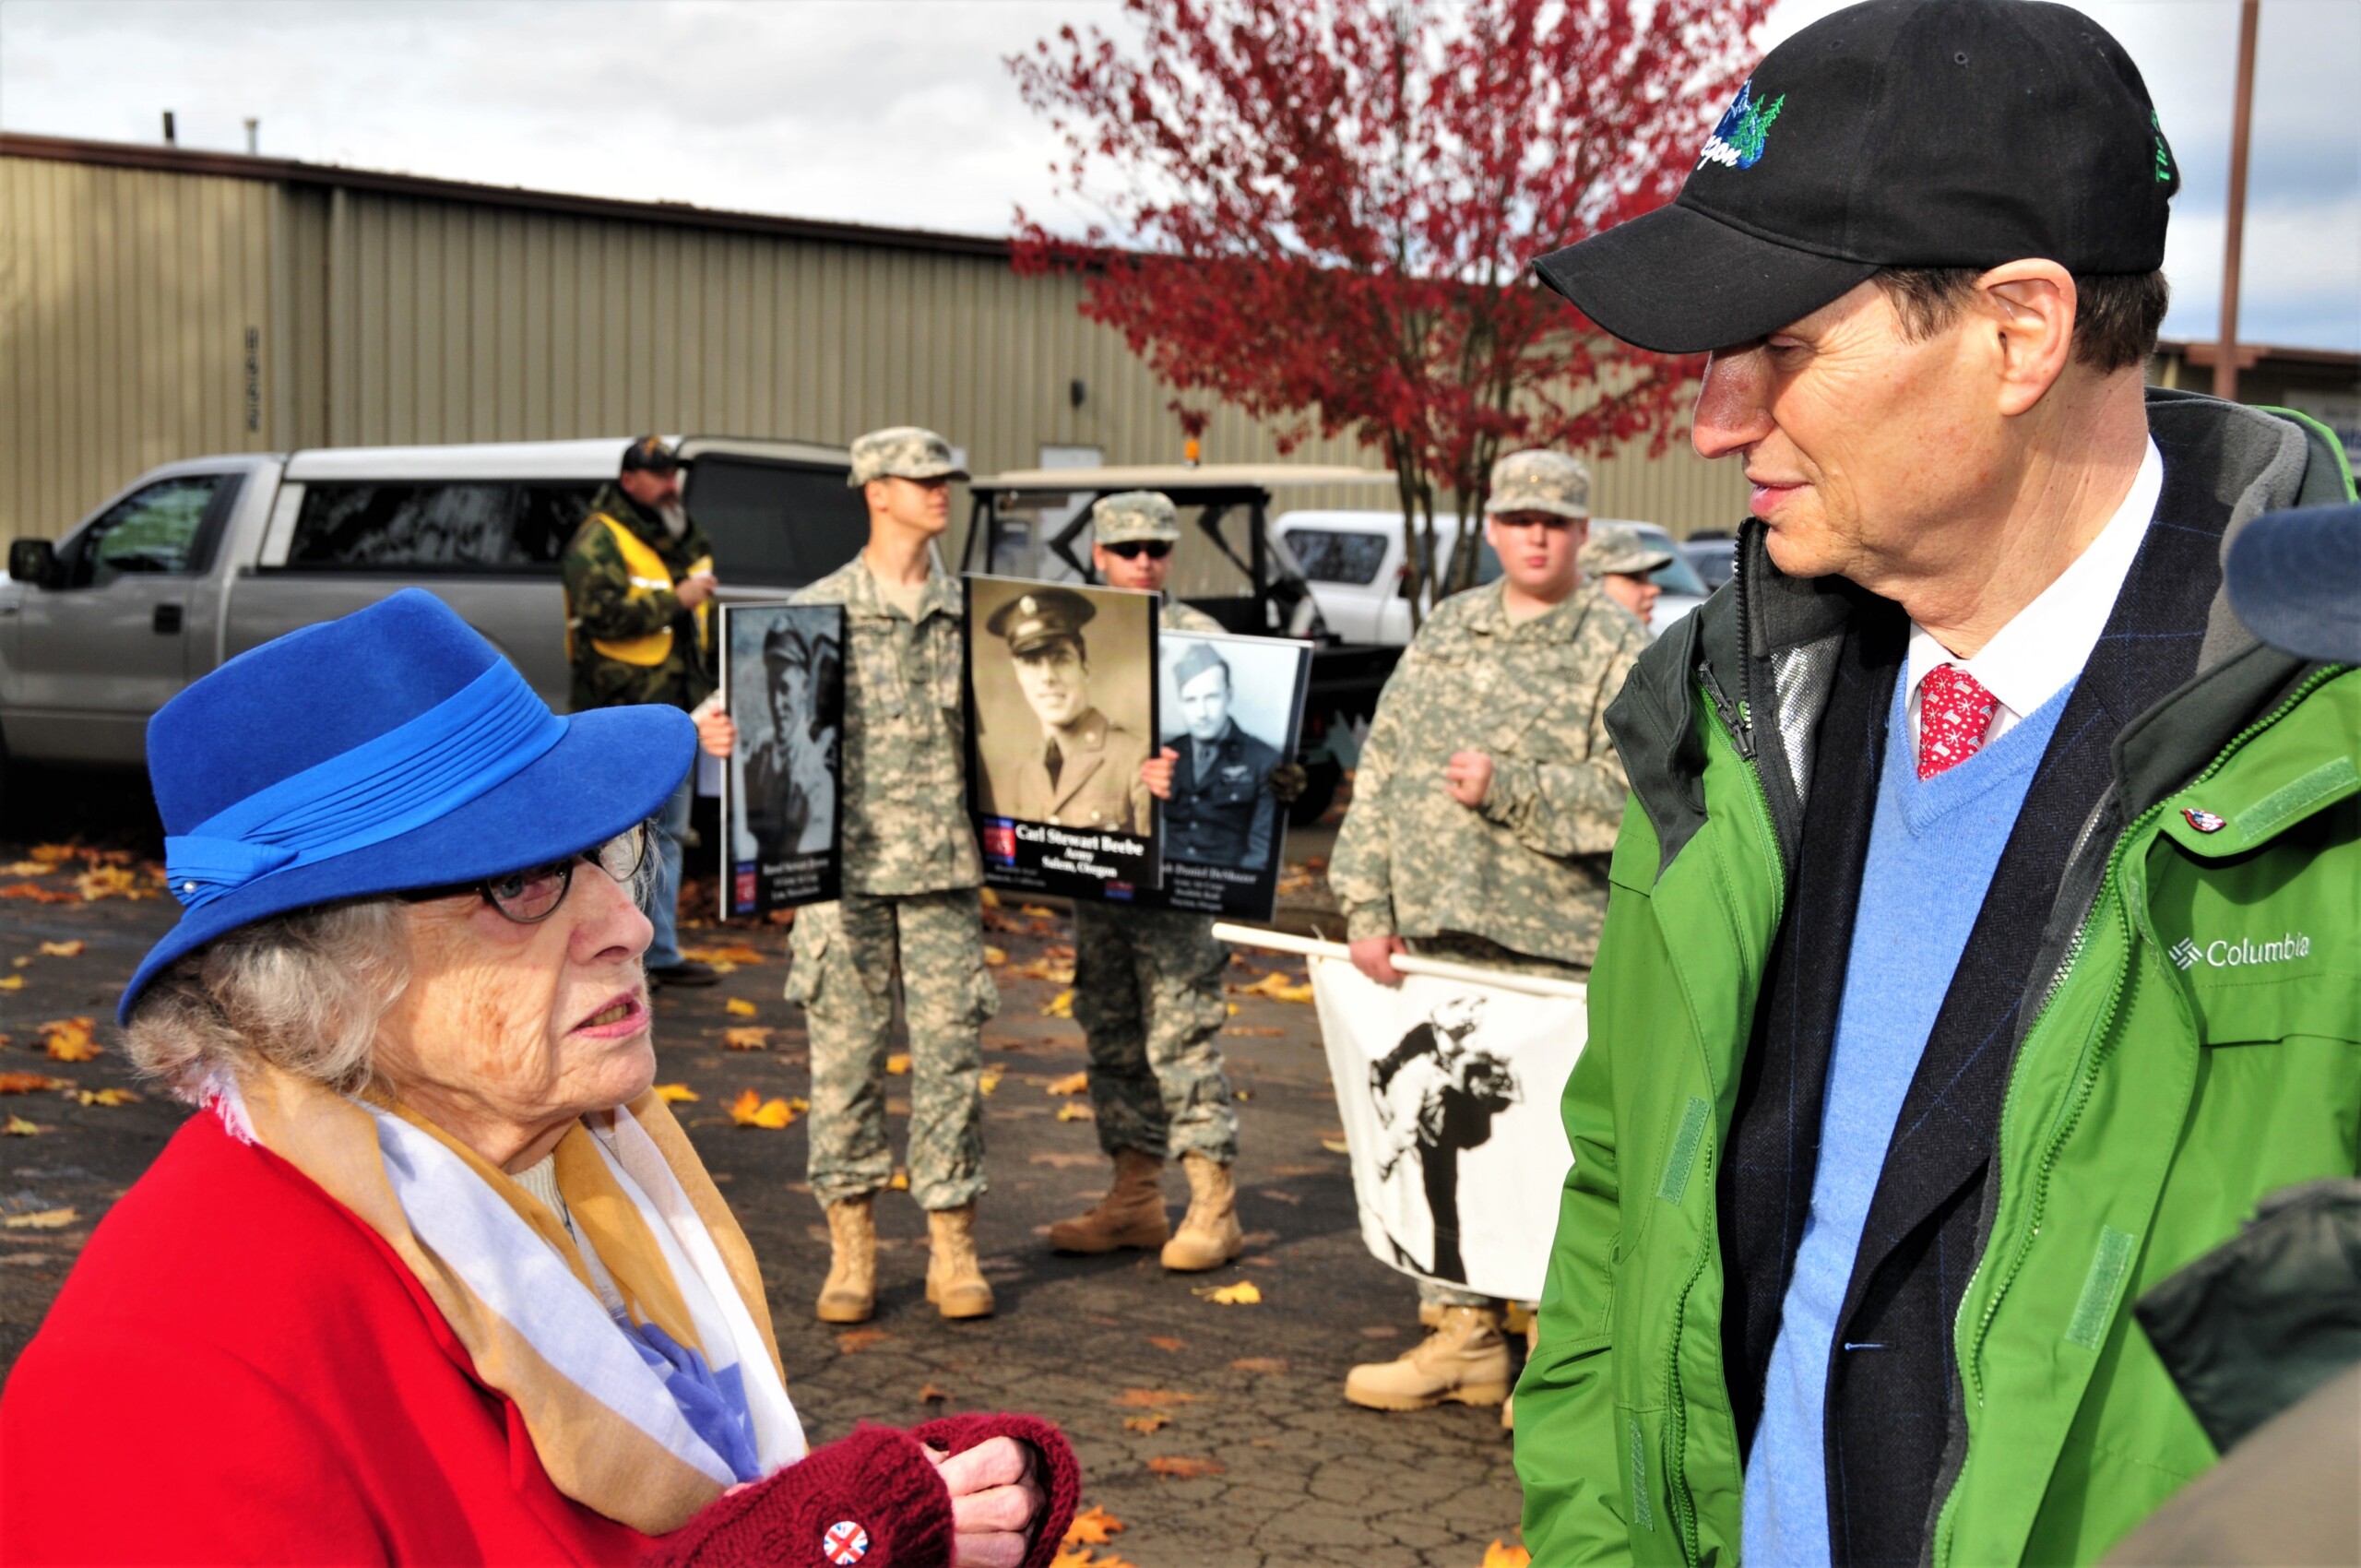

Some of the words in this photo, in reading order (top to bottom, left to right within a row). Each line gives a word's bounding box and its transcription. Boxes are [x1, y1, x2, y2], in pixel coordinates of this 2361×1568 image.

[1015, 824, 1045, 842] Carl
[1047, 828, 1099, 849] Stewart
[1101, 836, 1145, 856] Beebe
[1041, 855, 1077, 873] Salem,
[1076, 861, 1118, 879] Oregon
[1063, 847, 1095, 864] Army
[2206, 932, 2310, 967] Columbia
